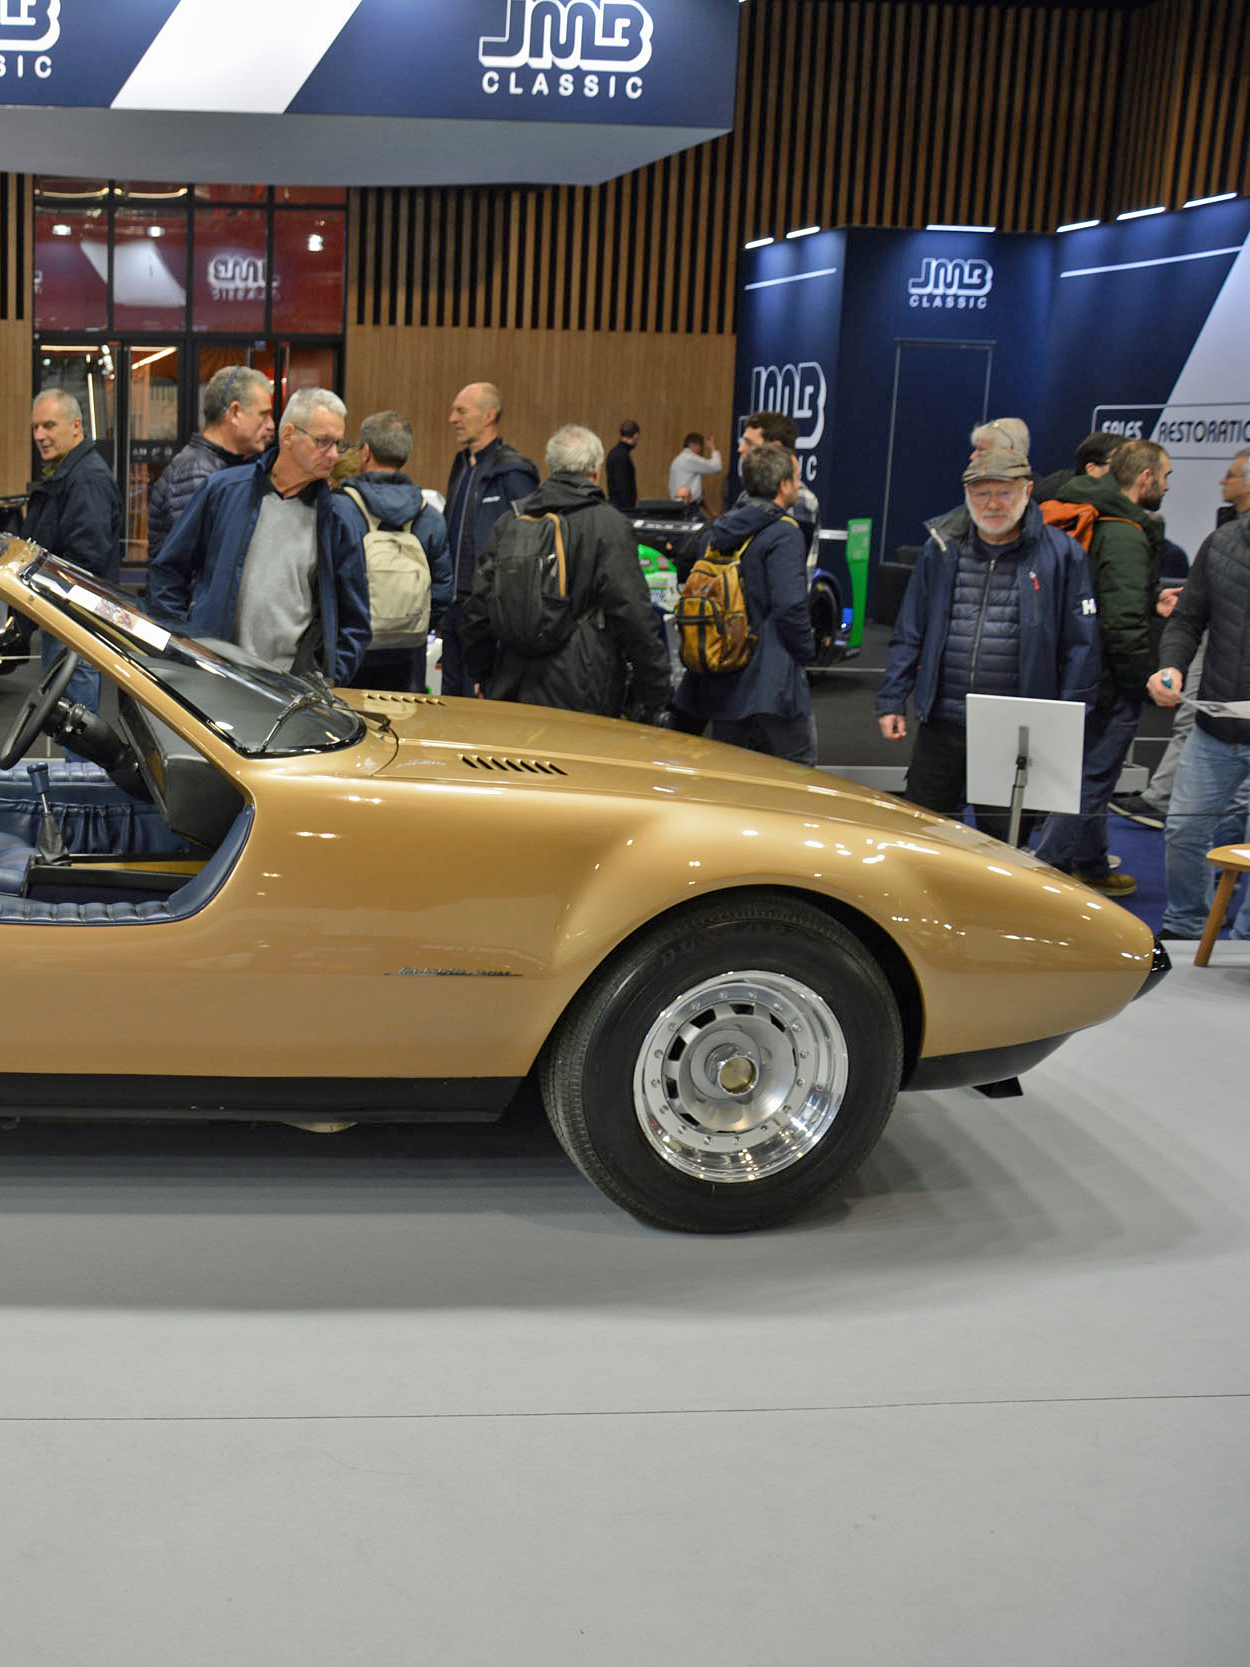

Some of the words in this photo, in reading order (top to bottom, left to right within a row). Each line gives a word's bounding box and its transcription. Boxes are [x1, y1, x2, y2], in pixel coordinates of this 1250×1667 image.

[478, 0, 654, 72] JMB
[482, 71, 643, 99] CLASSIC
[908, 257, 993, 296] JMB
[909, 295, 988, 309] CLASSIC
